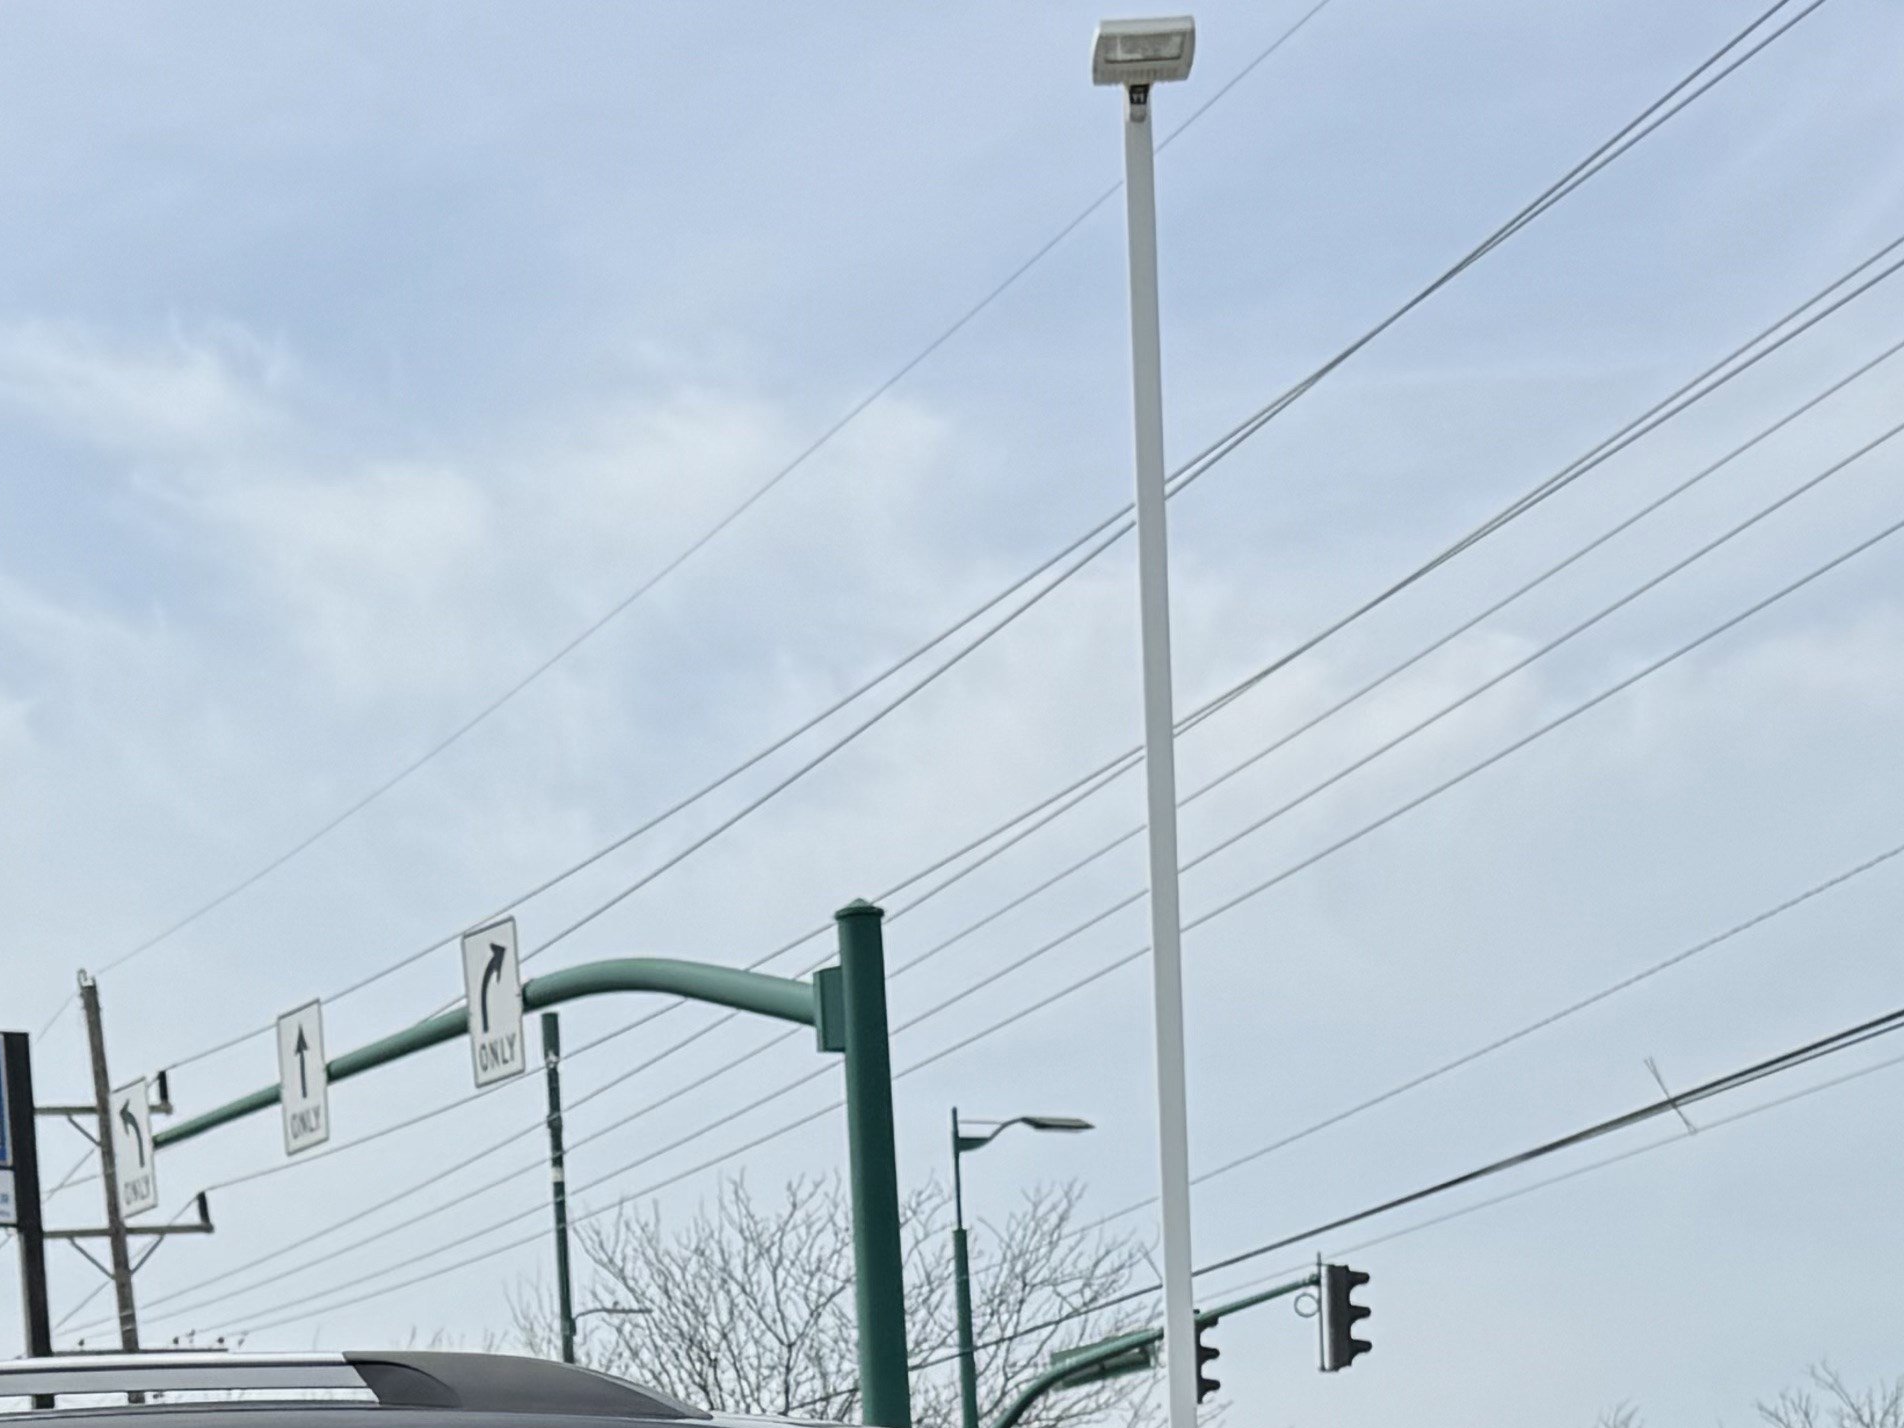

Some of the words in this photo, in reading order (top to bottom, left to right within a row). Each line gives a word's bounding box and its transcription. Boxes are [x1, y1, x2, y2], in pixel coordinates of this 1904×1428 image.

[479, 1033, 517, 1072] ONLY
[292, 1104, 320, 1140] ONLY
[123, 1174, 150, 1206] ONLY
